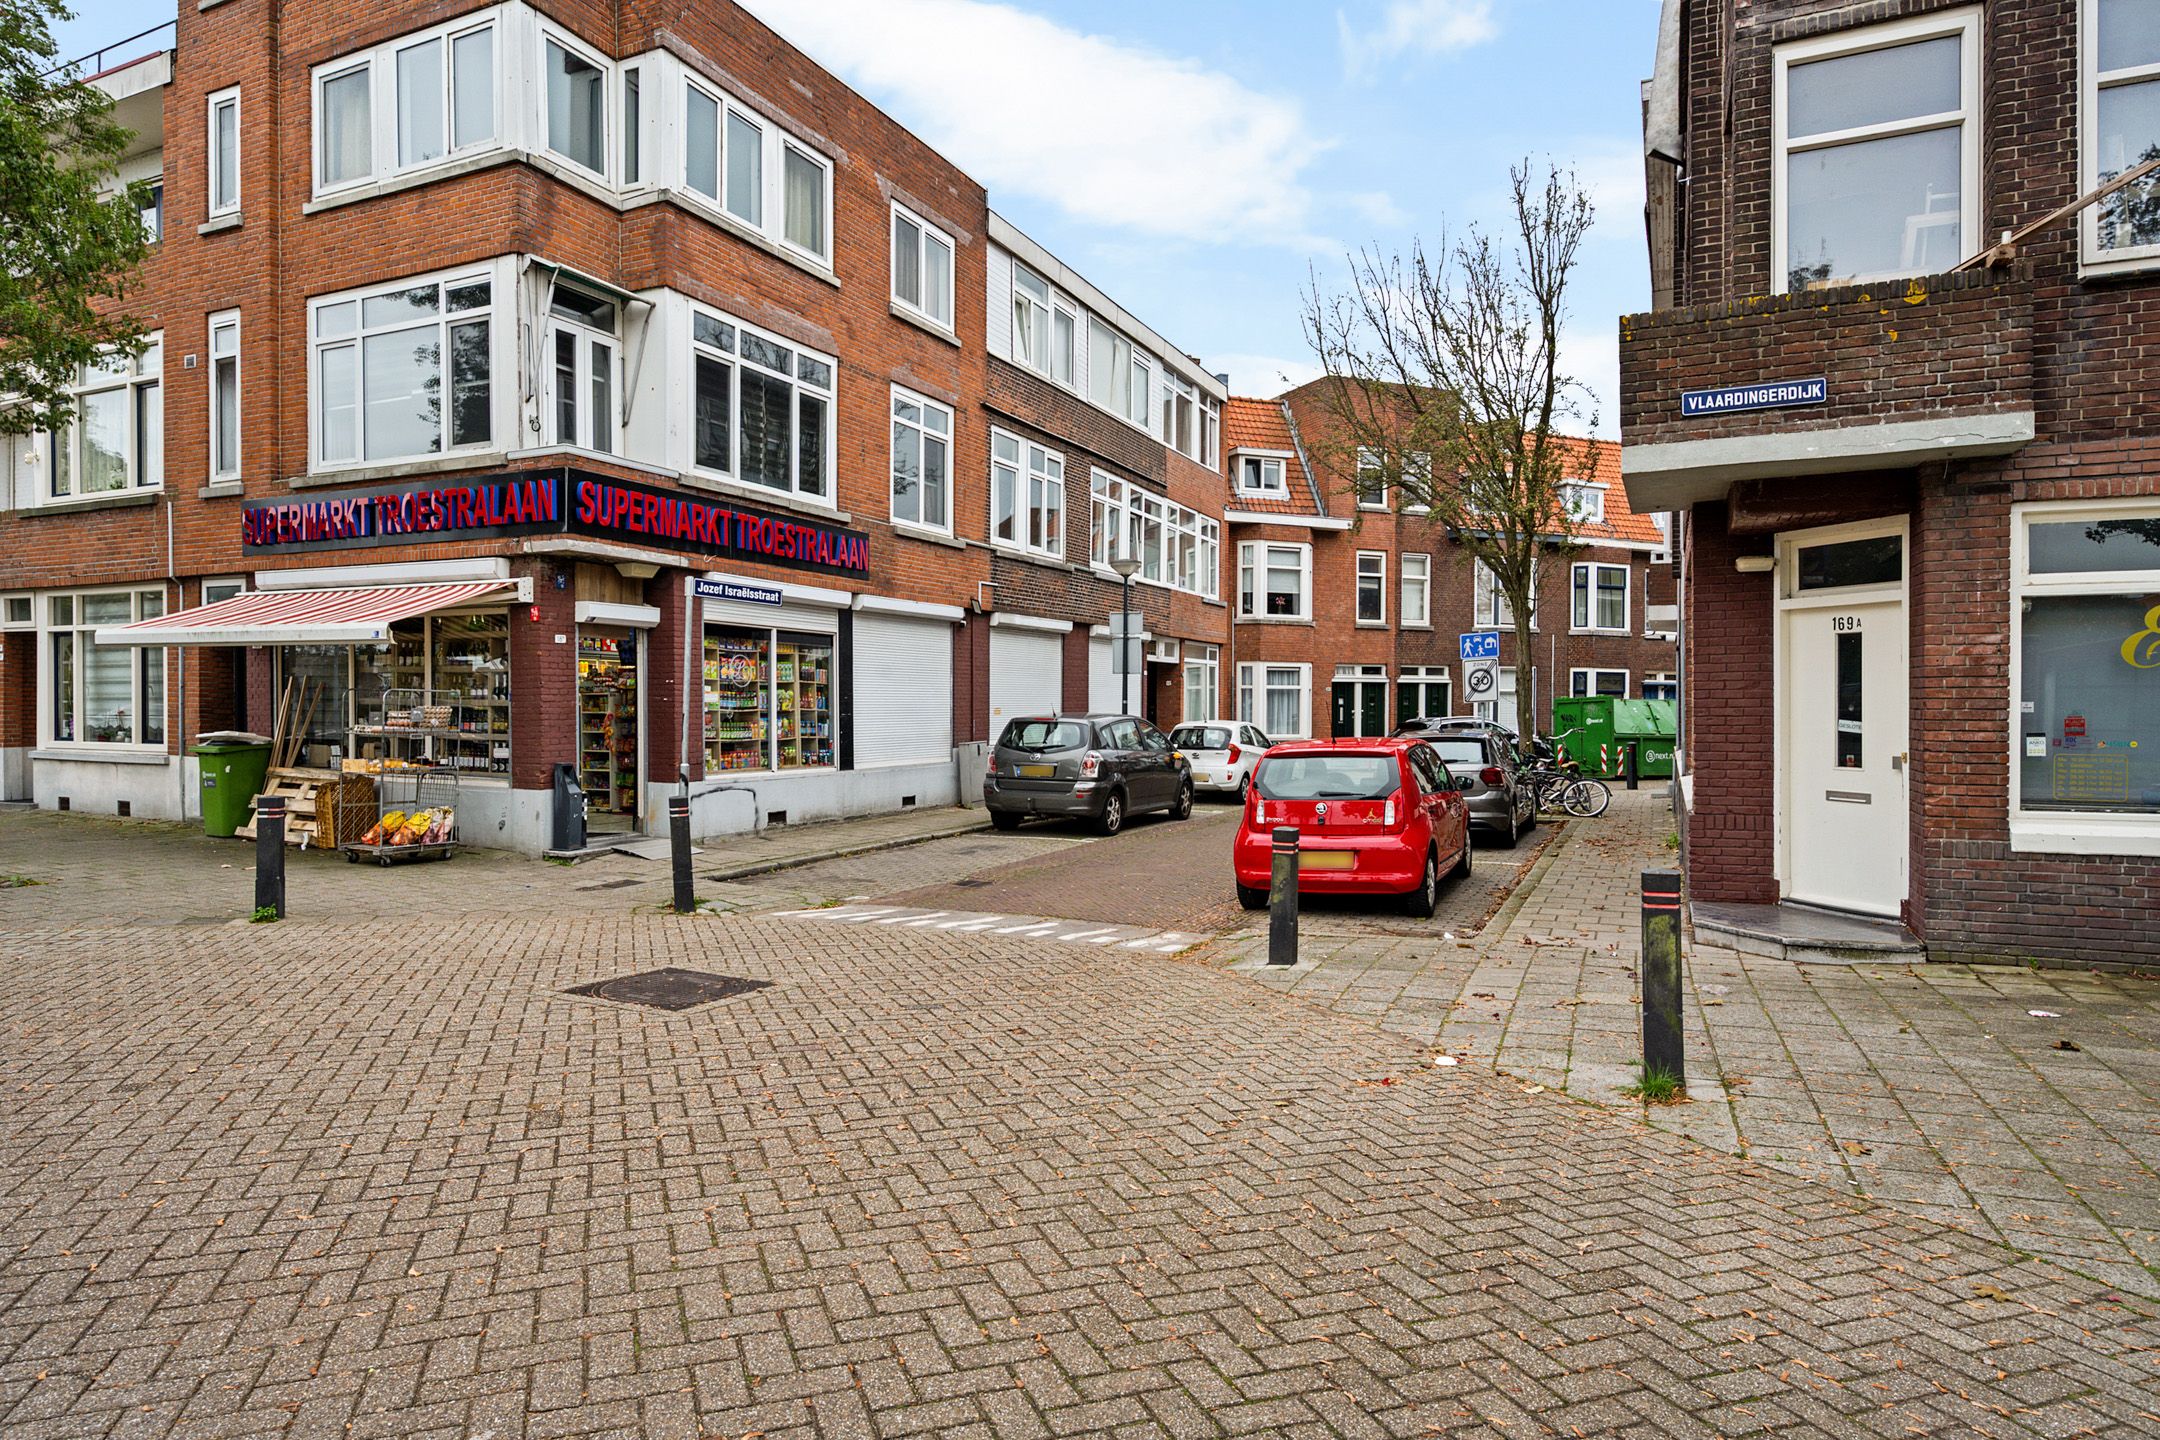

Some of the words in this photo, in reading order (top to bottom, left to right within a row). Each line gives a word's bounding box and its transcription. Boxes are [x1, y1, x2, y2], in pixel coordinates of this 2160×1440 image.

[1688, 383, 1822, 410] VLAARDINGERDIJK
[242, 497, 369, 545] SUPERMARKT
[374, 478, 557, 534] TROESTRALAAN
[576, 481, 732, 546] SUPERMARKT
[734, 511, 869, 571] TROESTRALAAN
[697, 582, 723, 595] Jozef
[725, 585, 780, 602] Israëlsstraat
[1472, 675, 1490, 686] 30
